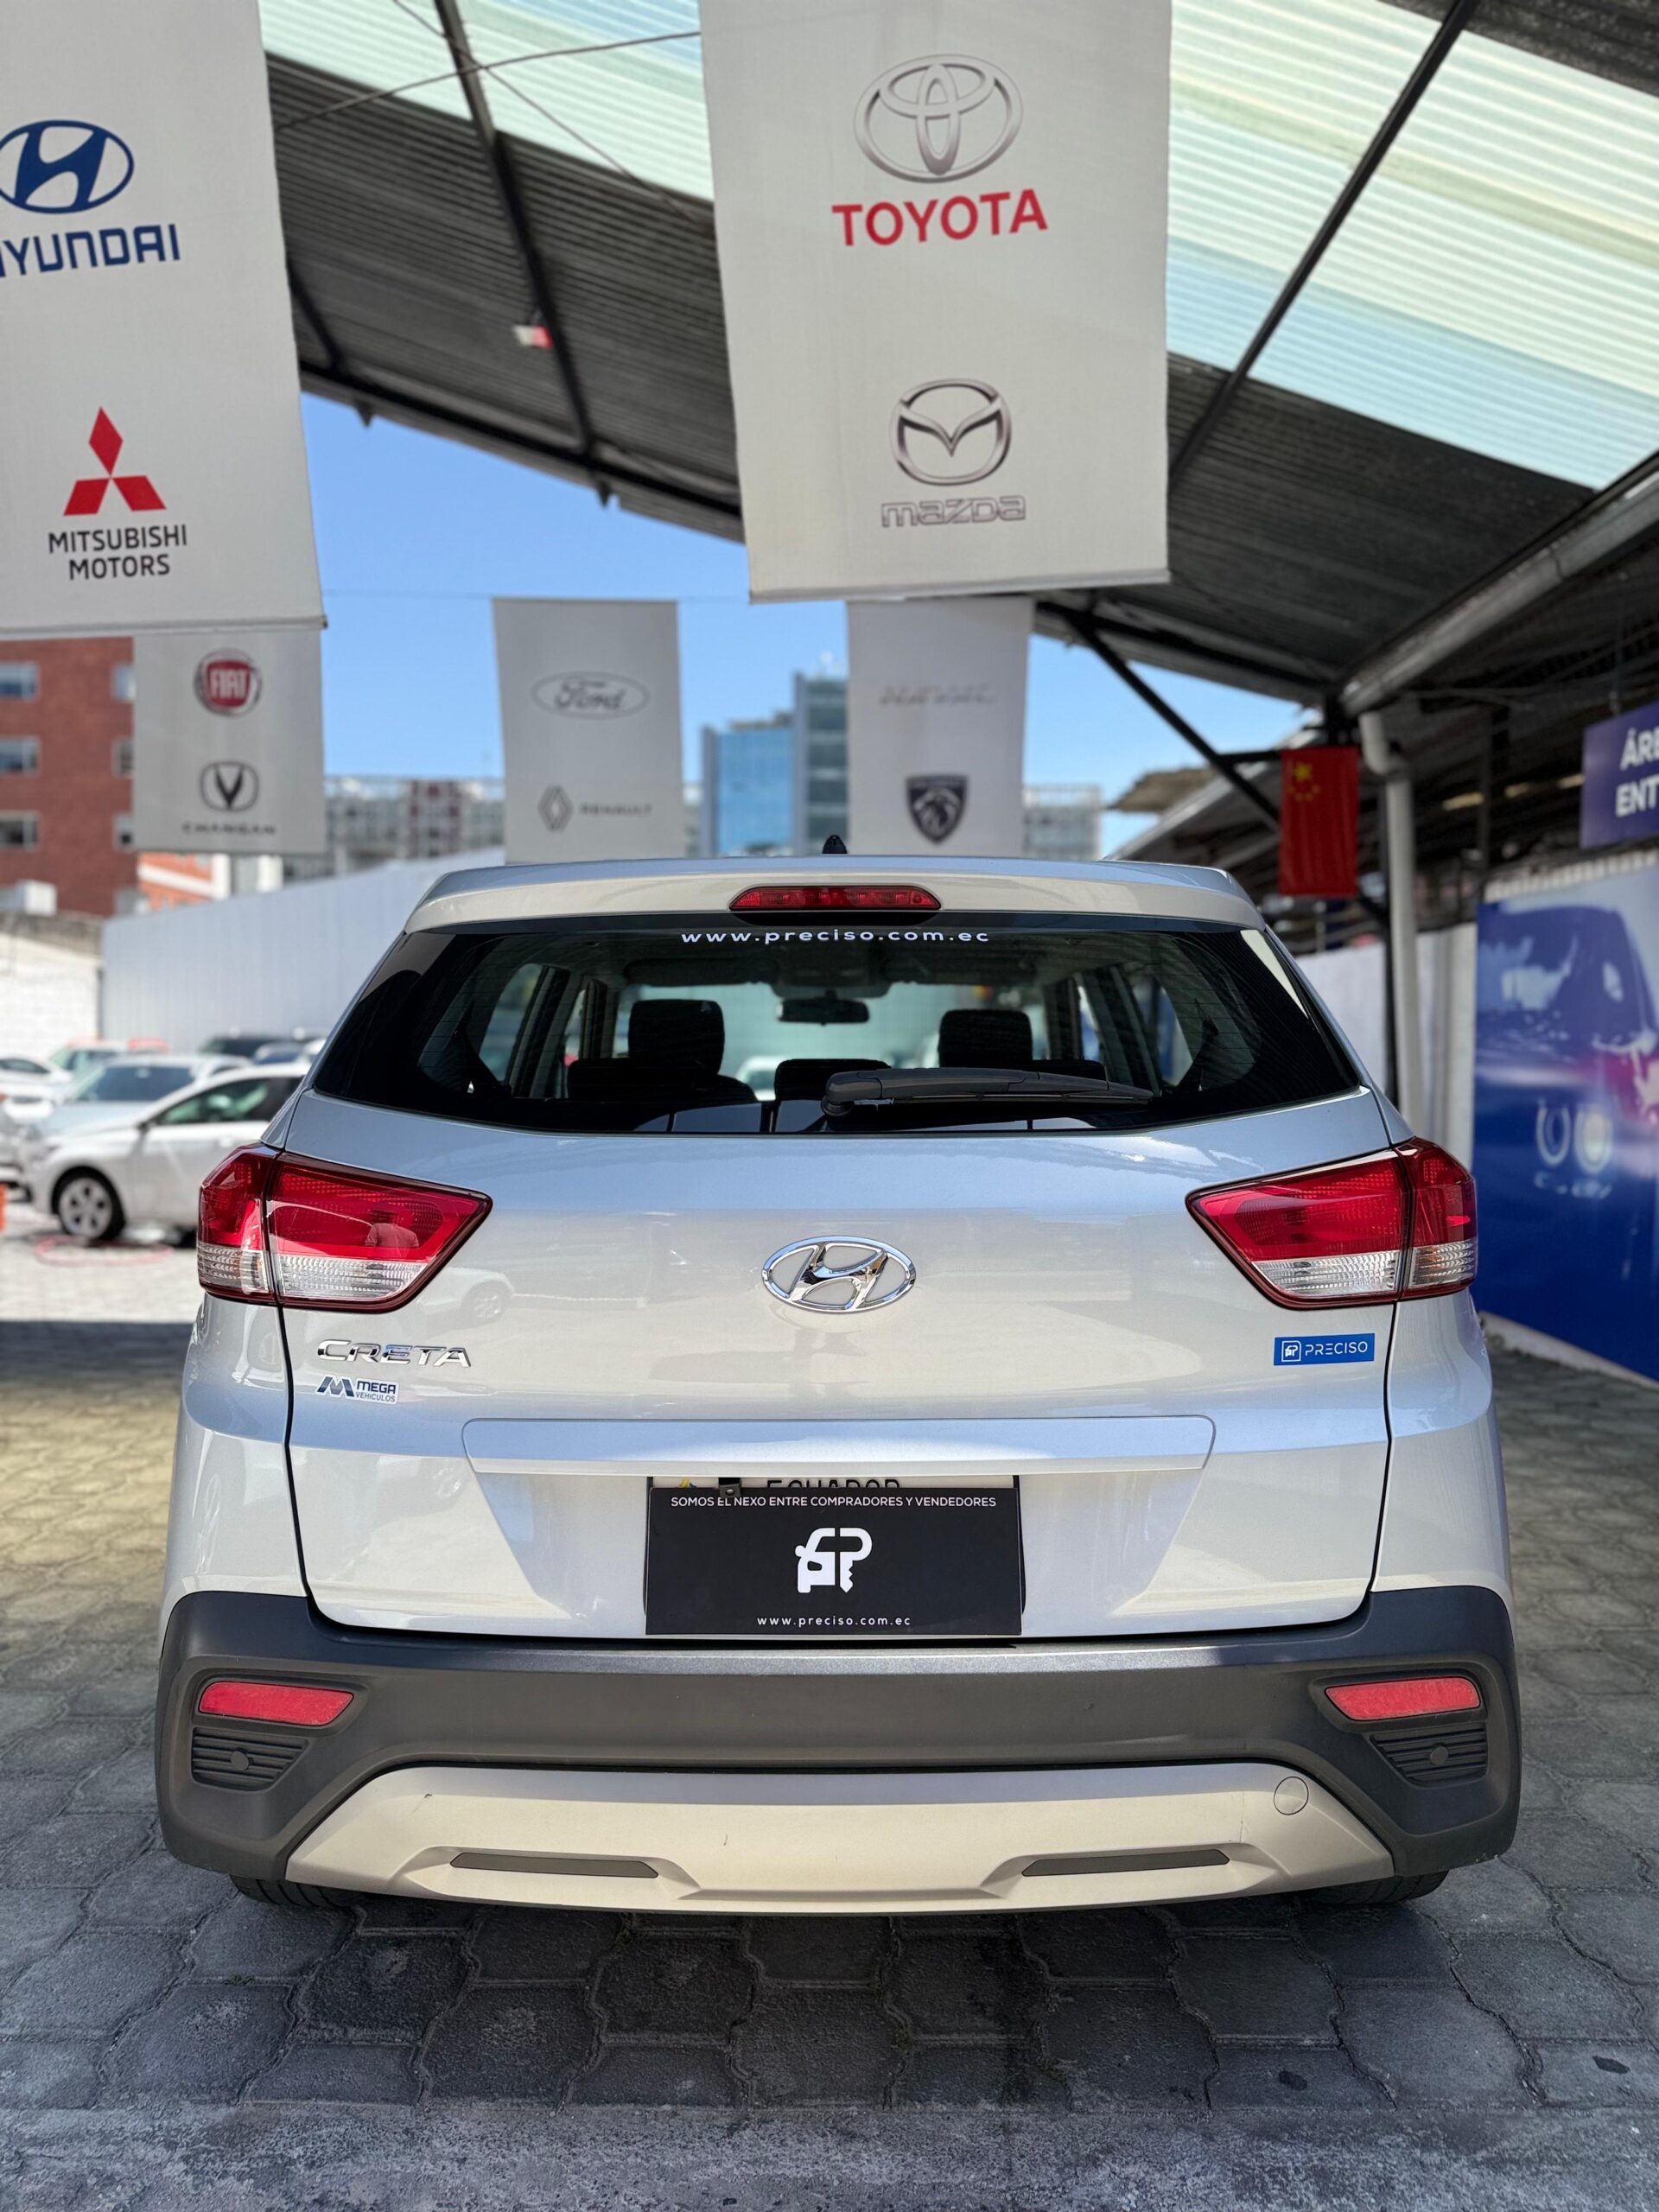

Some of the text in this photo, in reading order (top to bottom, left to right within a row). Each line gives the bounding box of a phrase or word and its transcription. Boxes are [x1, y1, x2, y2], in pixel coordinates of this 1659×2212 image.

[831, 188, 1048, 246] TOYOTA
[0, 224, 181, 277] YUNDAI
[48, 524, 188, 553] MITSUBISHI
[68, 555, 170, 580] MOTORS
[210, 669, 248, 699] FIAT
[554, 677, 628, 711] Ford
[681, 928, 988, 944] www.preciso.com.ec
[317, 1339, 472, 1368] CRETA
[1305, 1341, 1368, 1356] PRECISO
[356, 1381, 397, 1394] MEGA
[671, 1496, 996, 1507] SOMOS EL NEXO ENTRE COMPRADORES Y VENDEDORES
[757, 1615, 911, 1627] www.preciso.com.ec
